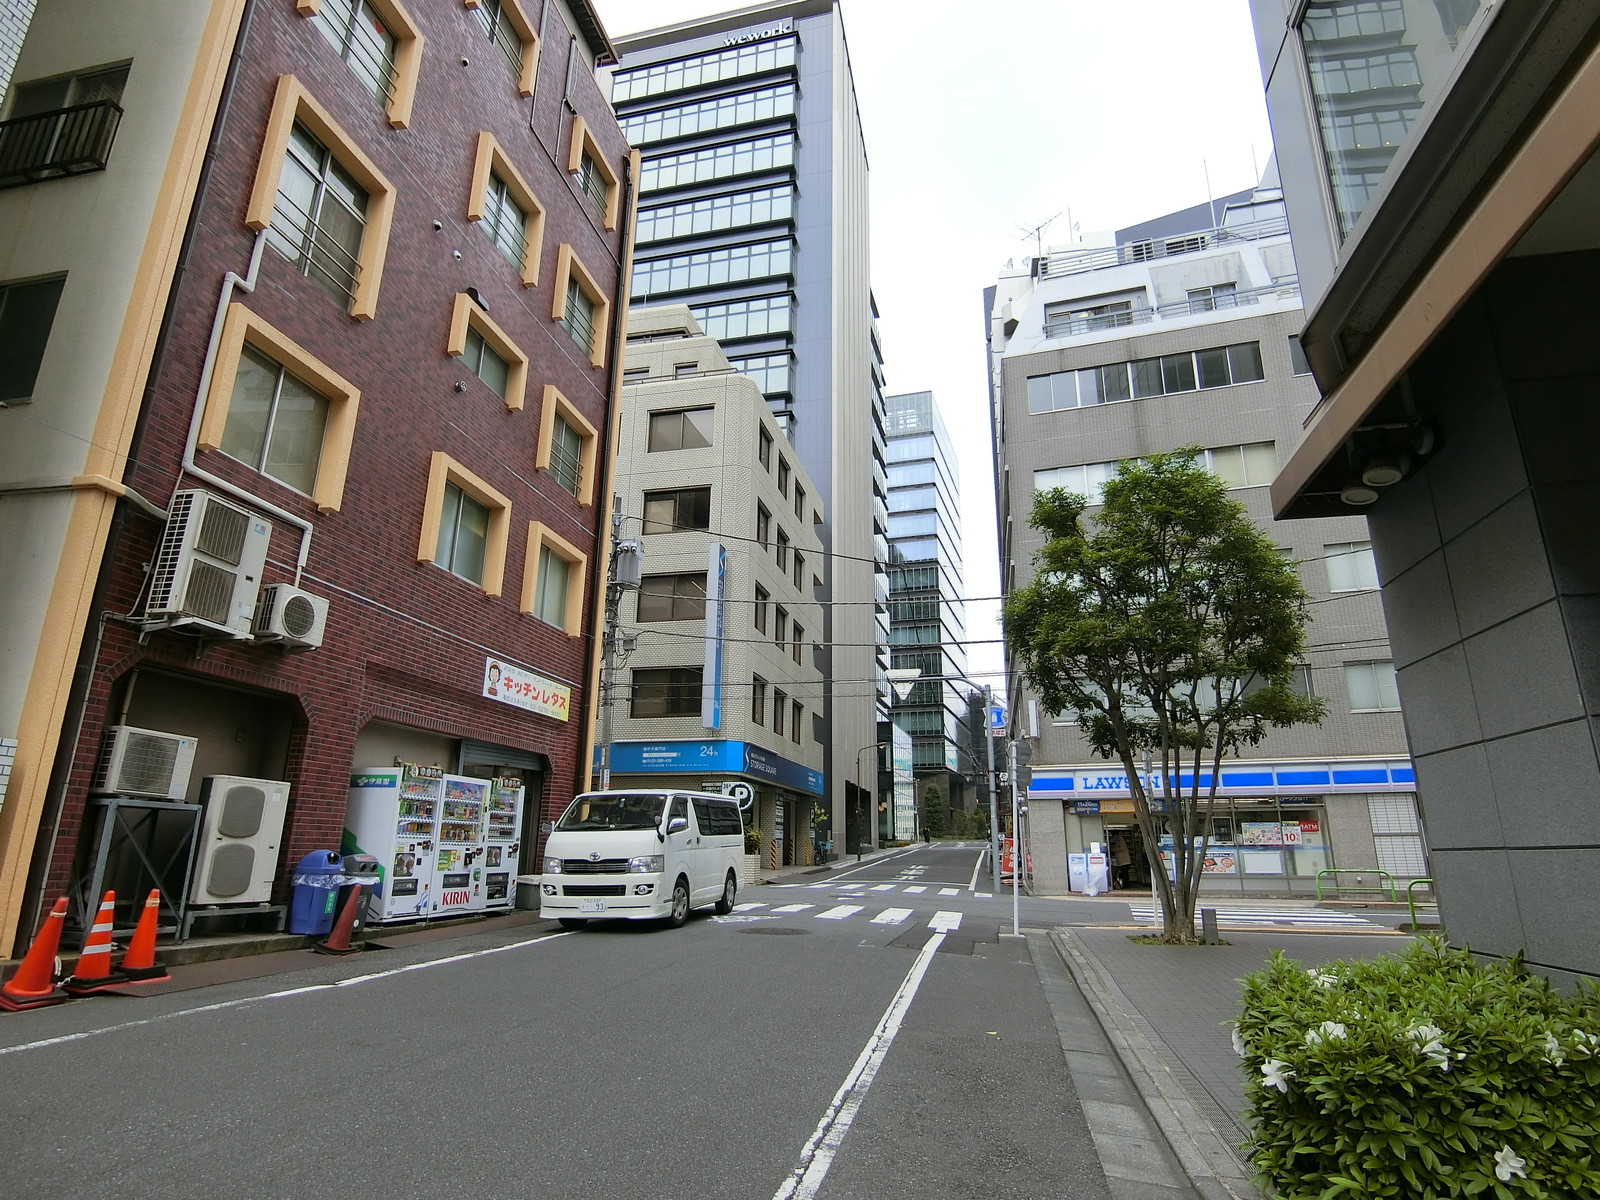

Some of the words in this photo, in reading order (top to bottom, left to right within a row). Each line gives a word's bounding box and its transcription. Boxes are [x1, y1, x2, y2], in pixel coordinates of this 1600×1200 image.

[723, 22, 791, 46] wework
[503, 676, 567, 710] キッチンレタス
[700, 746, 719, 757] 24h
[735, 787, 748, 806] P
[442, 891, 471, 906] KIRIN
[595, 902, 604, 911] 93
